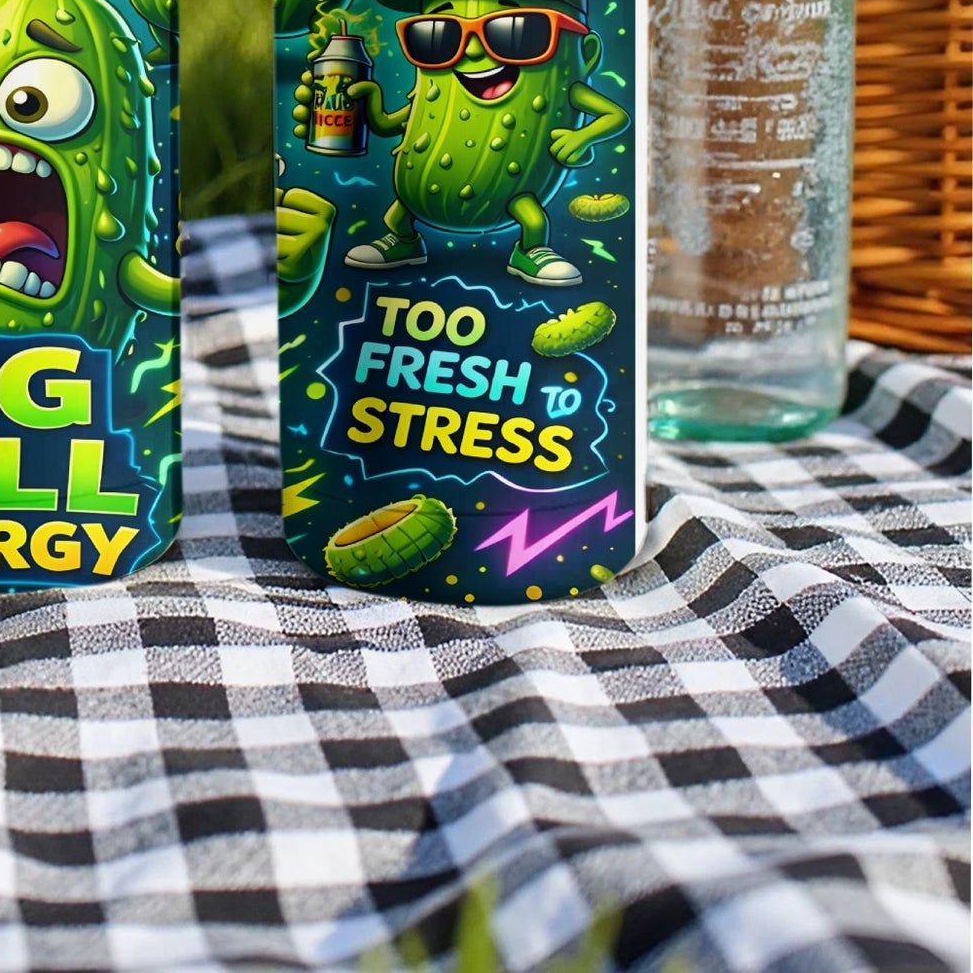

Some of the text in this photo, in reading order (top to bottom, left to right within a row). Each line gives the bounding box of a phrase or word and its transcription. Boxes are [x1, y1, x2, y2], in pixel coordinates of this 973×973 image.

[376, 296, 486, 347] TOO
[354, 341, 582, 419] FRESH TO
[347, 397, 574, 472] STRESS
